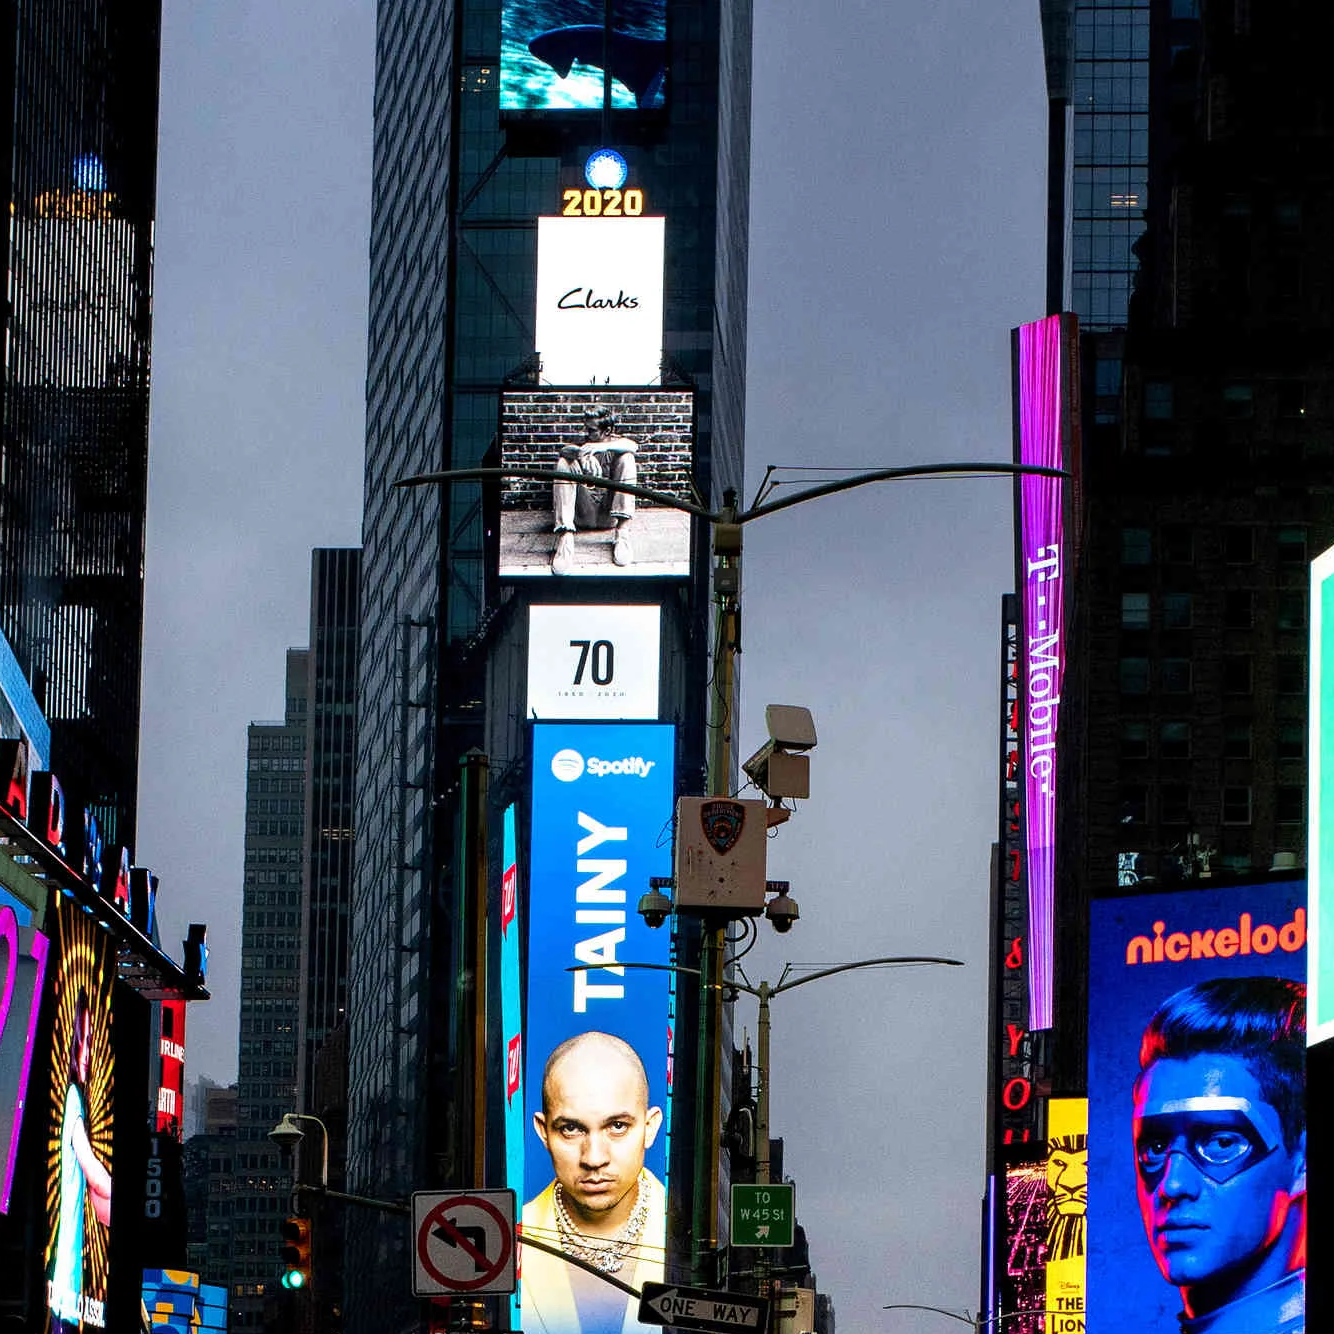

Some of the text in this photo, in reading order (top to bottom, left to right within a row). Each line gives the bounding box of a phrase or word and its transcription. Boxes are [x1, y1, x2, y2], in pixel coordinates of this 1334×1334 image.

[563, 189, 643, 216] 2020
[557, 287, 639, 310] Clarks
[570, 639, 615, 687] 70
[586, 755, 655, 779] Spotify
[573, 810, 629, 1014] TAINY
[1125, 906, 1307, 966] nickelod
[754, 1191, 771, 1205] TO
[772, 1208, 785, 1221] St
[660, 1298, 753, 1324] ONE WAY
[1056, 1297, 1084, 1310] THE
